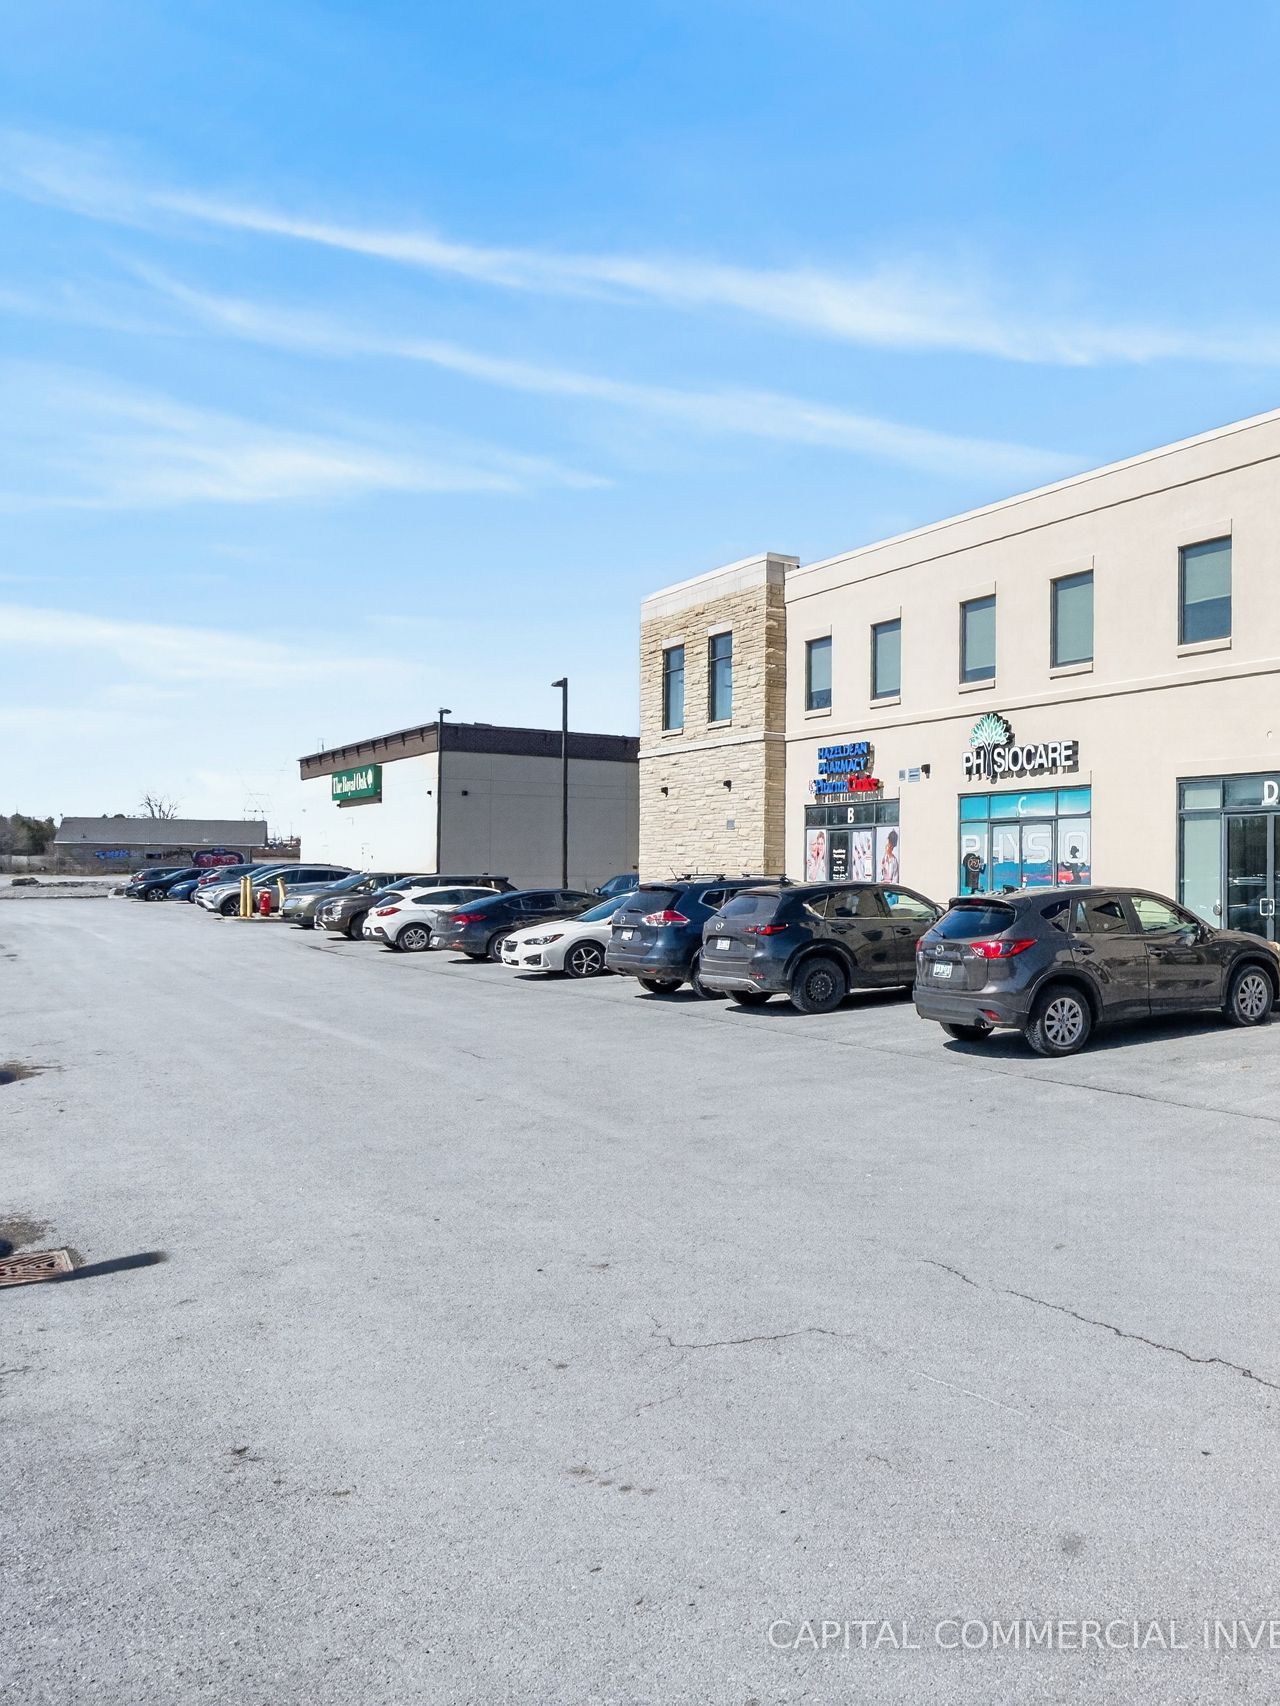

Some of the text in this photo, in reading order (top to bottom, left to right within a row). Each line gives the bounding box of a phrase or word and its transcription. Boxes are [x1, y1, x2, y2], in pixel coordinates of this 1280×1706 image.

[818, 757, 868, 774] PHARMACY
[963, 740, 1074, 778] PHYSIOCARE
[356, 771, 368, 790] Oak
[1263, 780, 1280, 804] D
[1018, 796, 1027, 814] C
[847, 807, 855, 824] B
[960, 831, 1088, 866] PHYSO
